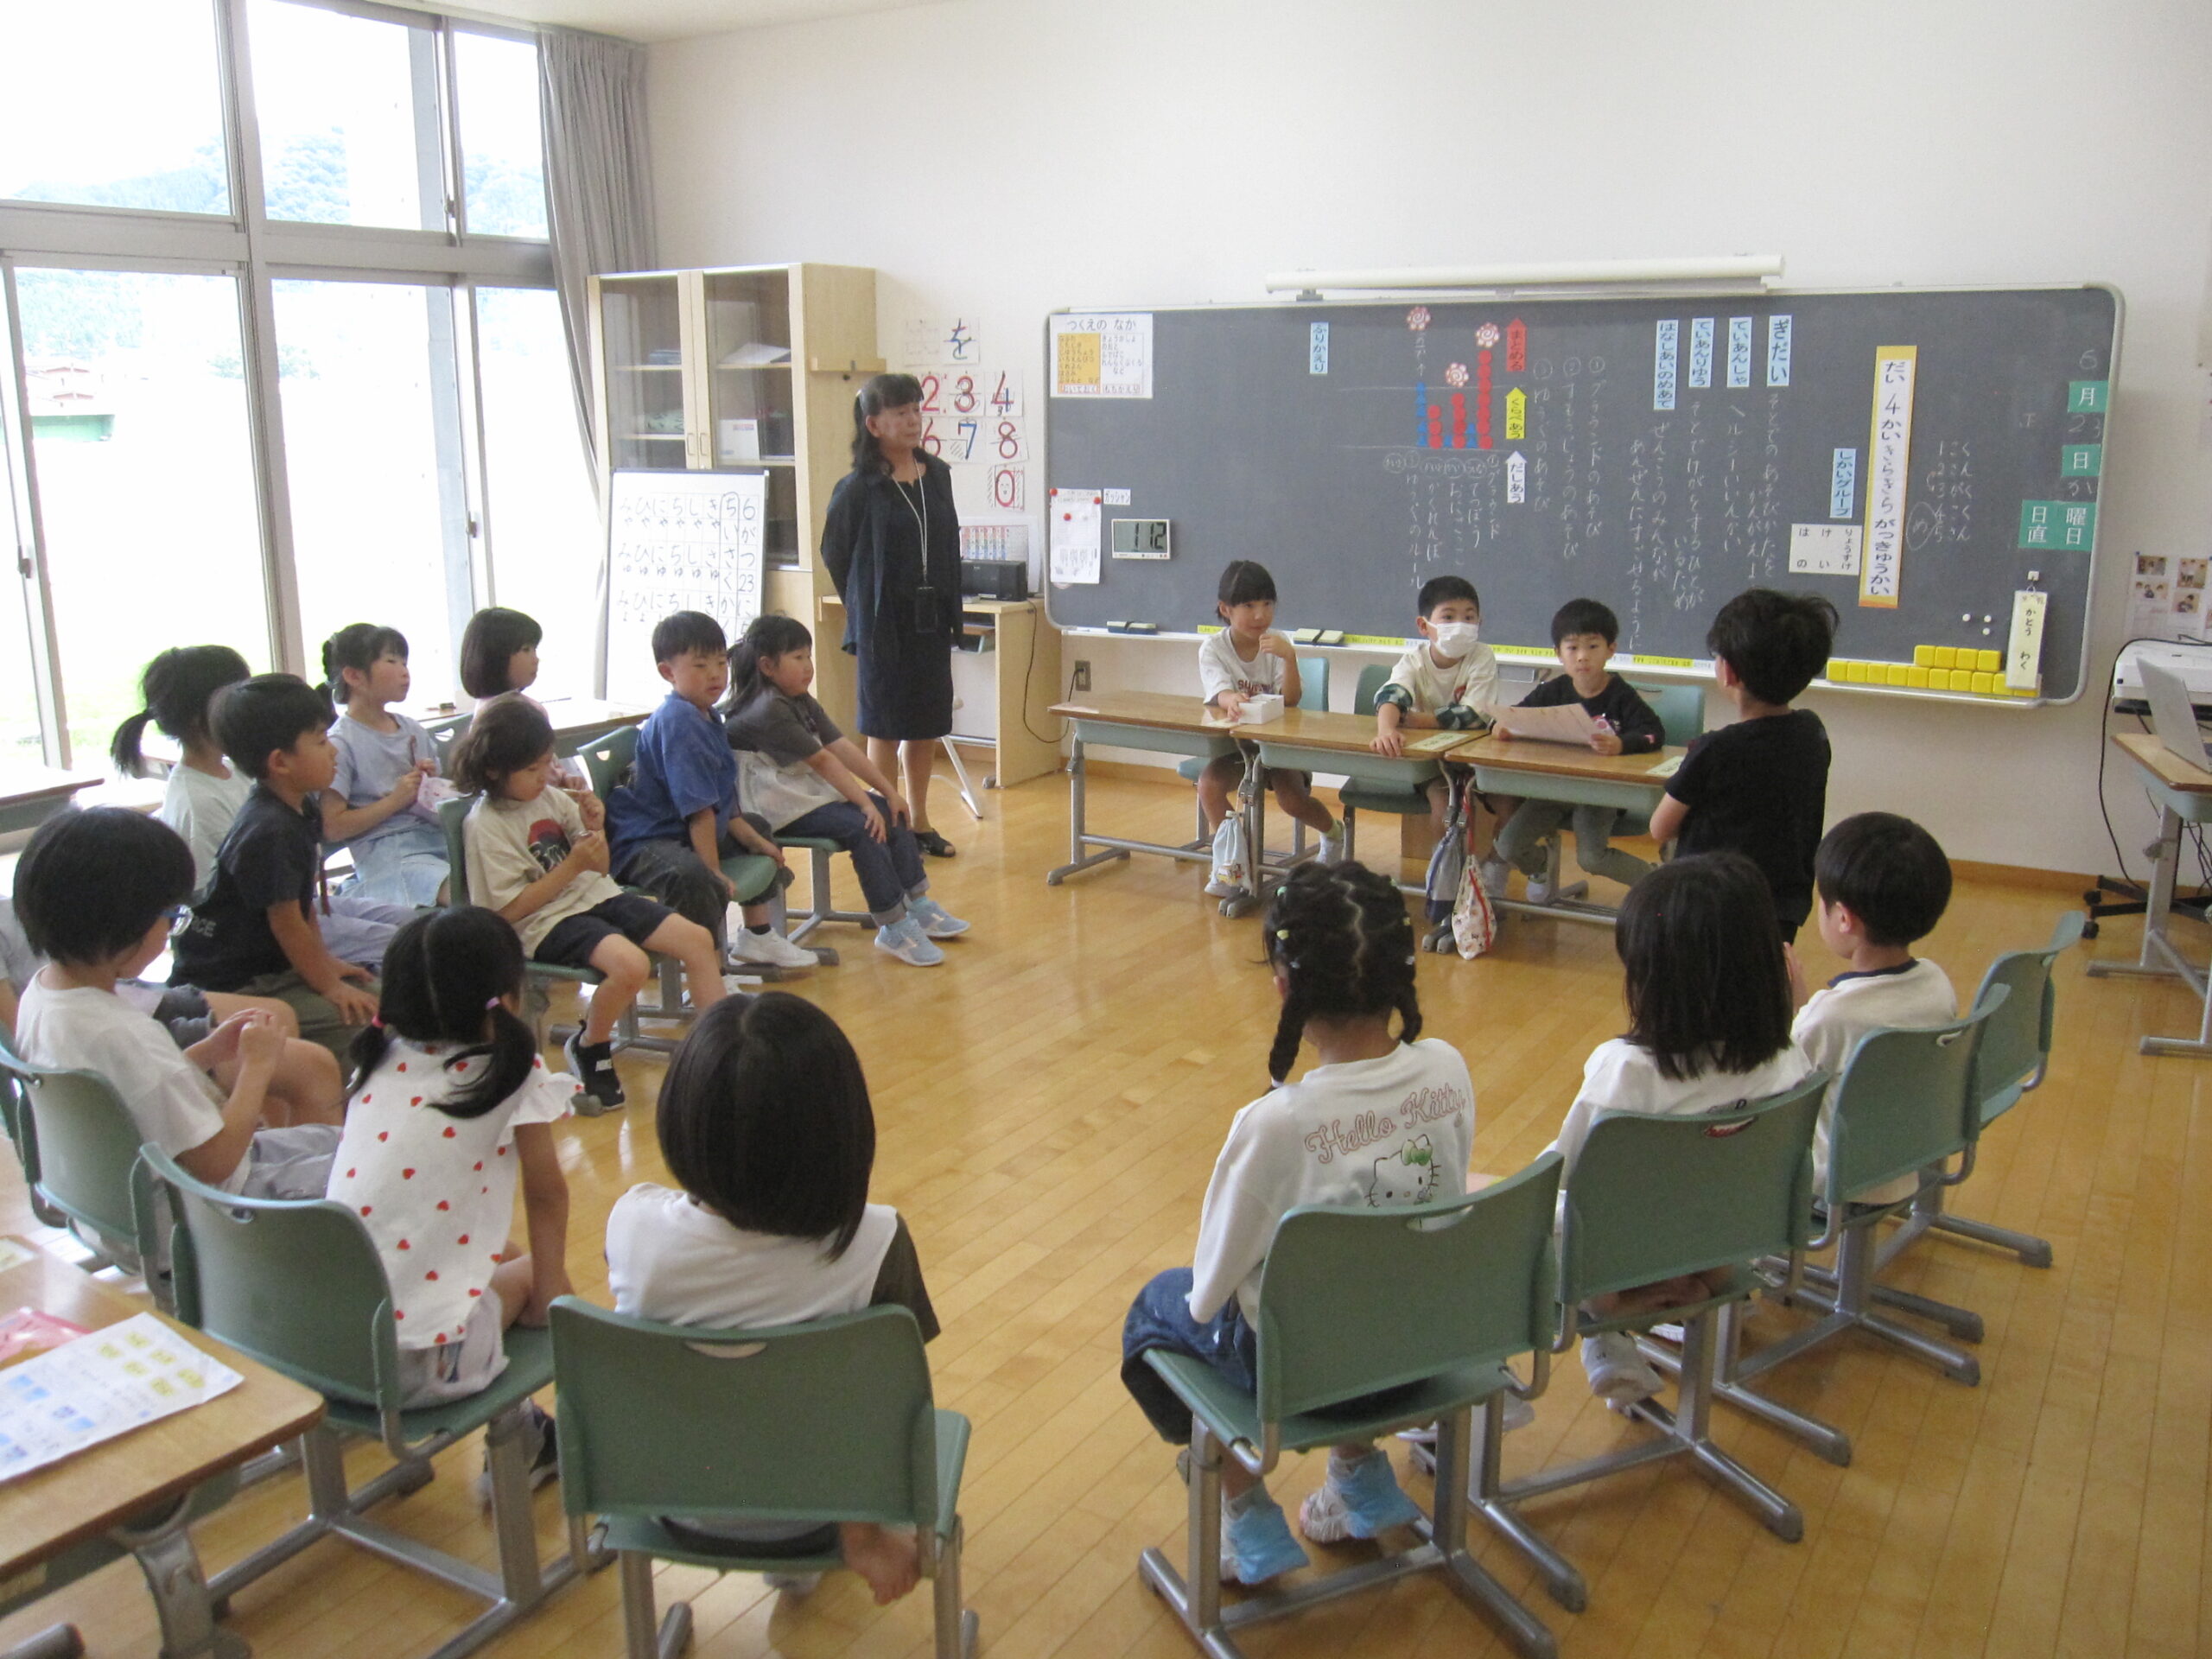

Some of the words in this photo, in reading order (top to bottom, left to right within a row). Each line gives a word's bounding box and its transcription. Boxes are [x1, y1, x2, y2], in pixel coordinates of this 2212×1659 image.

[951, 318, 972, 360] を
[1067, 318, 1107, 331] つくえの
[1114, 319, 1136, 331] なか
[1313, 324, 1327, 372] ふりかえり
[1510, 329, 1524, 371] まとめる
[1657, 322, 1676, 408] はなしあいのめあて
[1691, 321, 1713, 386] ていあんりゆう
[1732, 321, 1749, 385] ていあんしゃ
[1770, 319, 1790, 381] ぎだい
[920, 375, 940, 412] 2
[954, 375, 976, 413] 3
[991, 372, 1014, 413] 4
[2078, 387, 2096, 406] 月
[922, 417, 941, 457] 6
[957, 422, 977, 460] 7
[998, 421, 1018, 459] 8
[2074, 452, 2088, 469] 日
[995, 469, 1015, 507] 0
[1510, 462, 1523, 503] だしあう
[1834, 450, 1853, 517] しかいグループ
[2027, 505, 2048, 543] 日直
[2066, 506, 2088, 546] 曜日
[1796, 528, 1809, 569] はの
[1819, 529, 1832, 568] けい
[2024, 608, 2037, 637] かとう
[1304, 1109, 1397, 1164] Hello
[1400, 1082, 1466, 1129] Kitty
